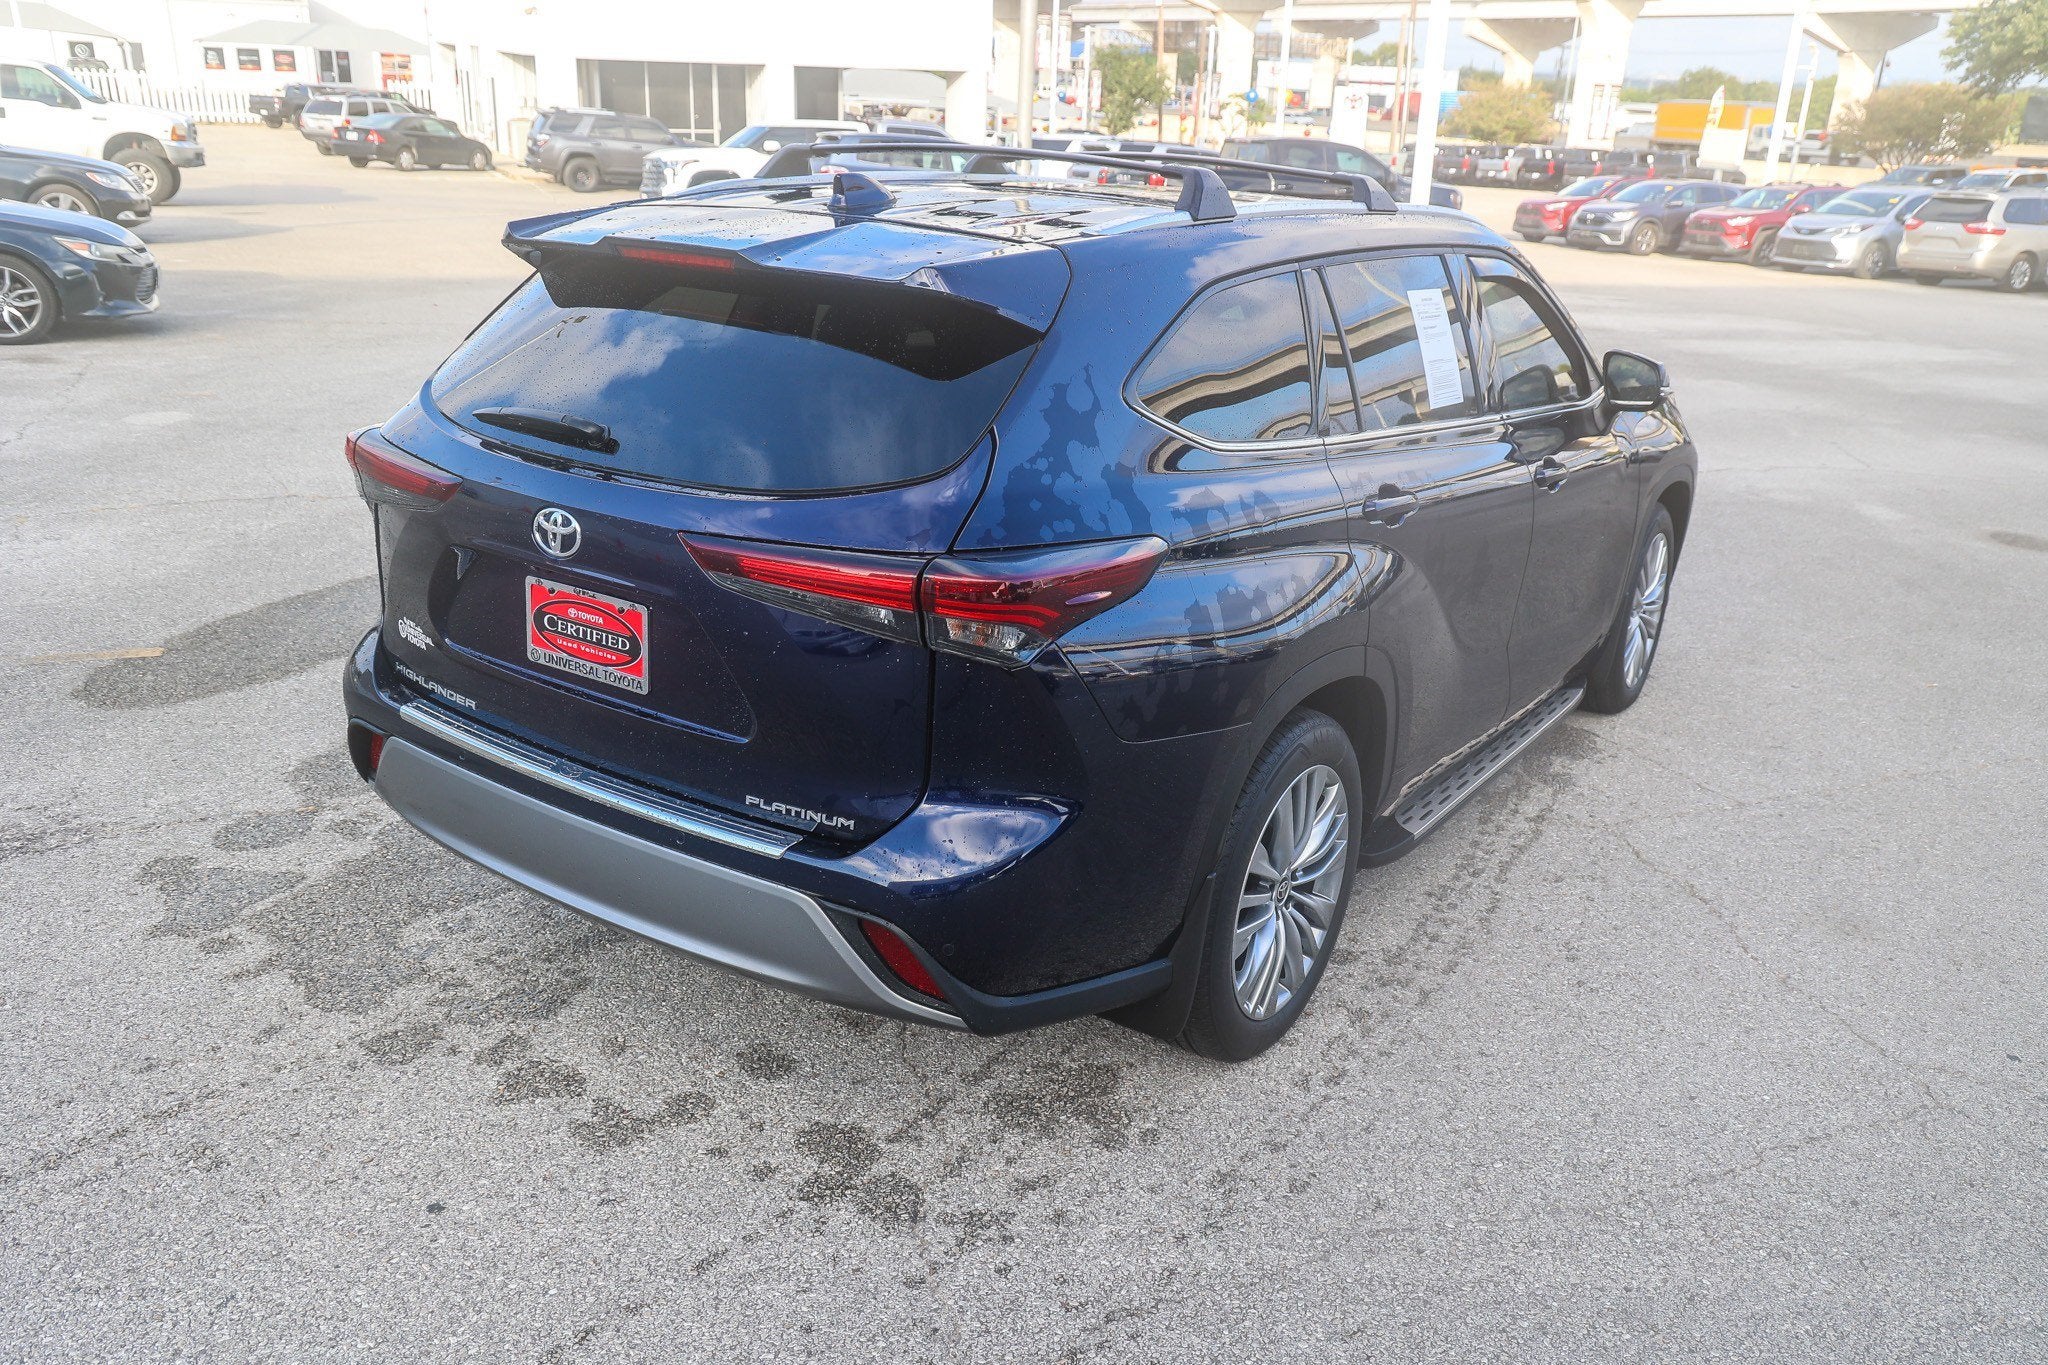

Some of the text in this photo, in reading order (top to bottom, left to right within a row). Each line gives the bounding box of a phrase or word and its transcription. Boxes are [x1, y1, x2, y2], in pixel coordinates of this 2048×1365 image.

[543, 614, 630, 651] CERTIFIED
[577, 611, 604, 625] TOYOTA
[557, 638, 617, 661] Used Vehicles
[395, 661, 476, 710] HIGHLANDER
[543, 652, 643, 692] UNIVERSAL TOYOTA
[745, 795, 855, 831] PLATINUM
